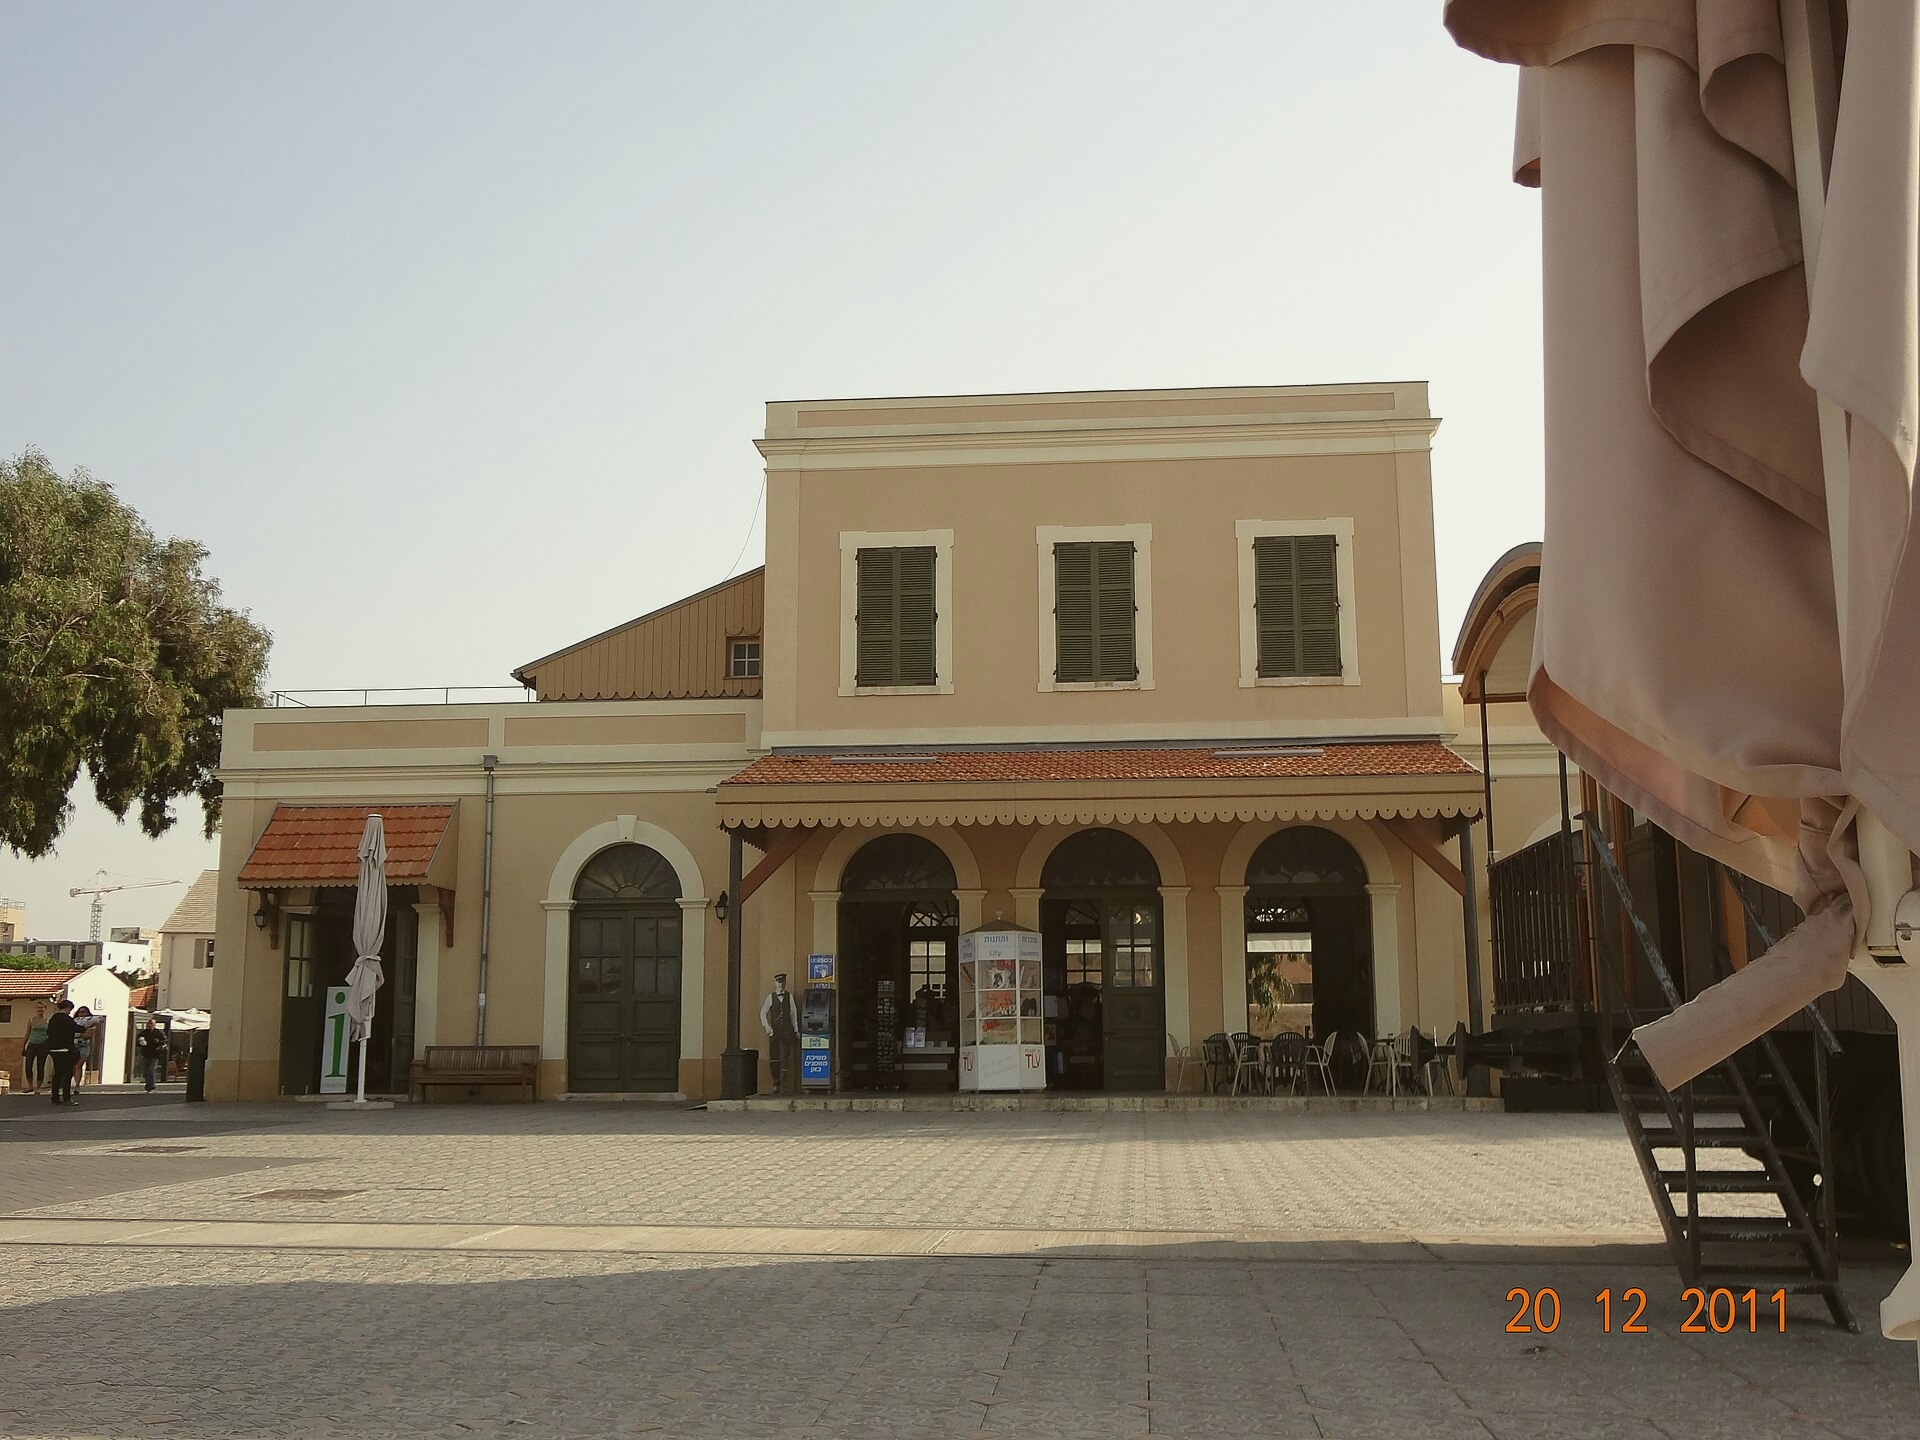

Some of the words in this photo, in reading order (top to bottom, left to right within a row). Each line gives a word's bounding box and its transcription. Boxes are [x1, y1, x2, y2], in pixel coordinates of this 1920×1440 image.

[324, 991, 346, 1078] i
[963, 1056, 974, 1071] TLV
[1025, 1053, 1041, 1069] TLV
